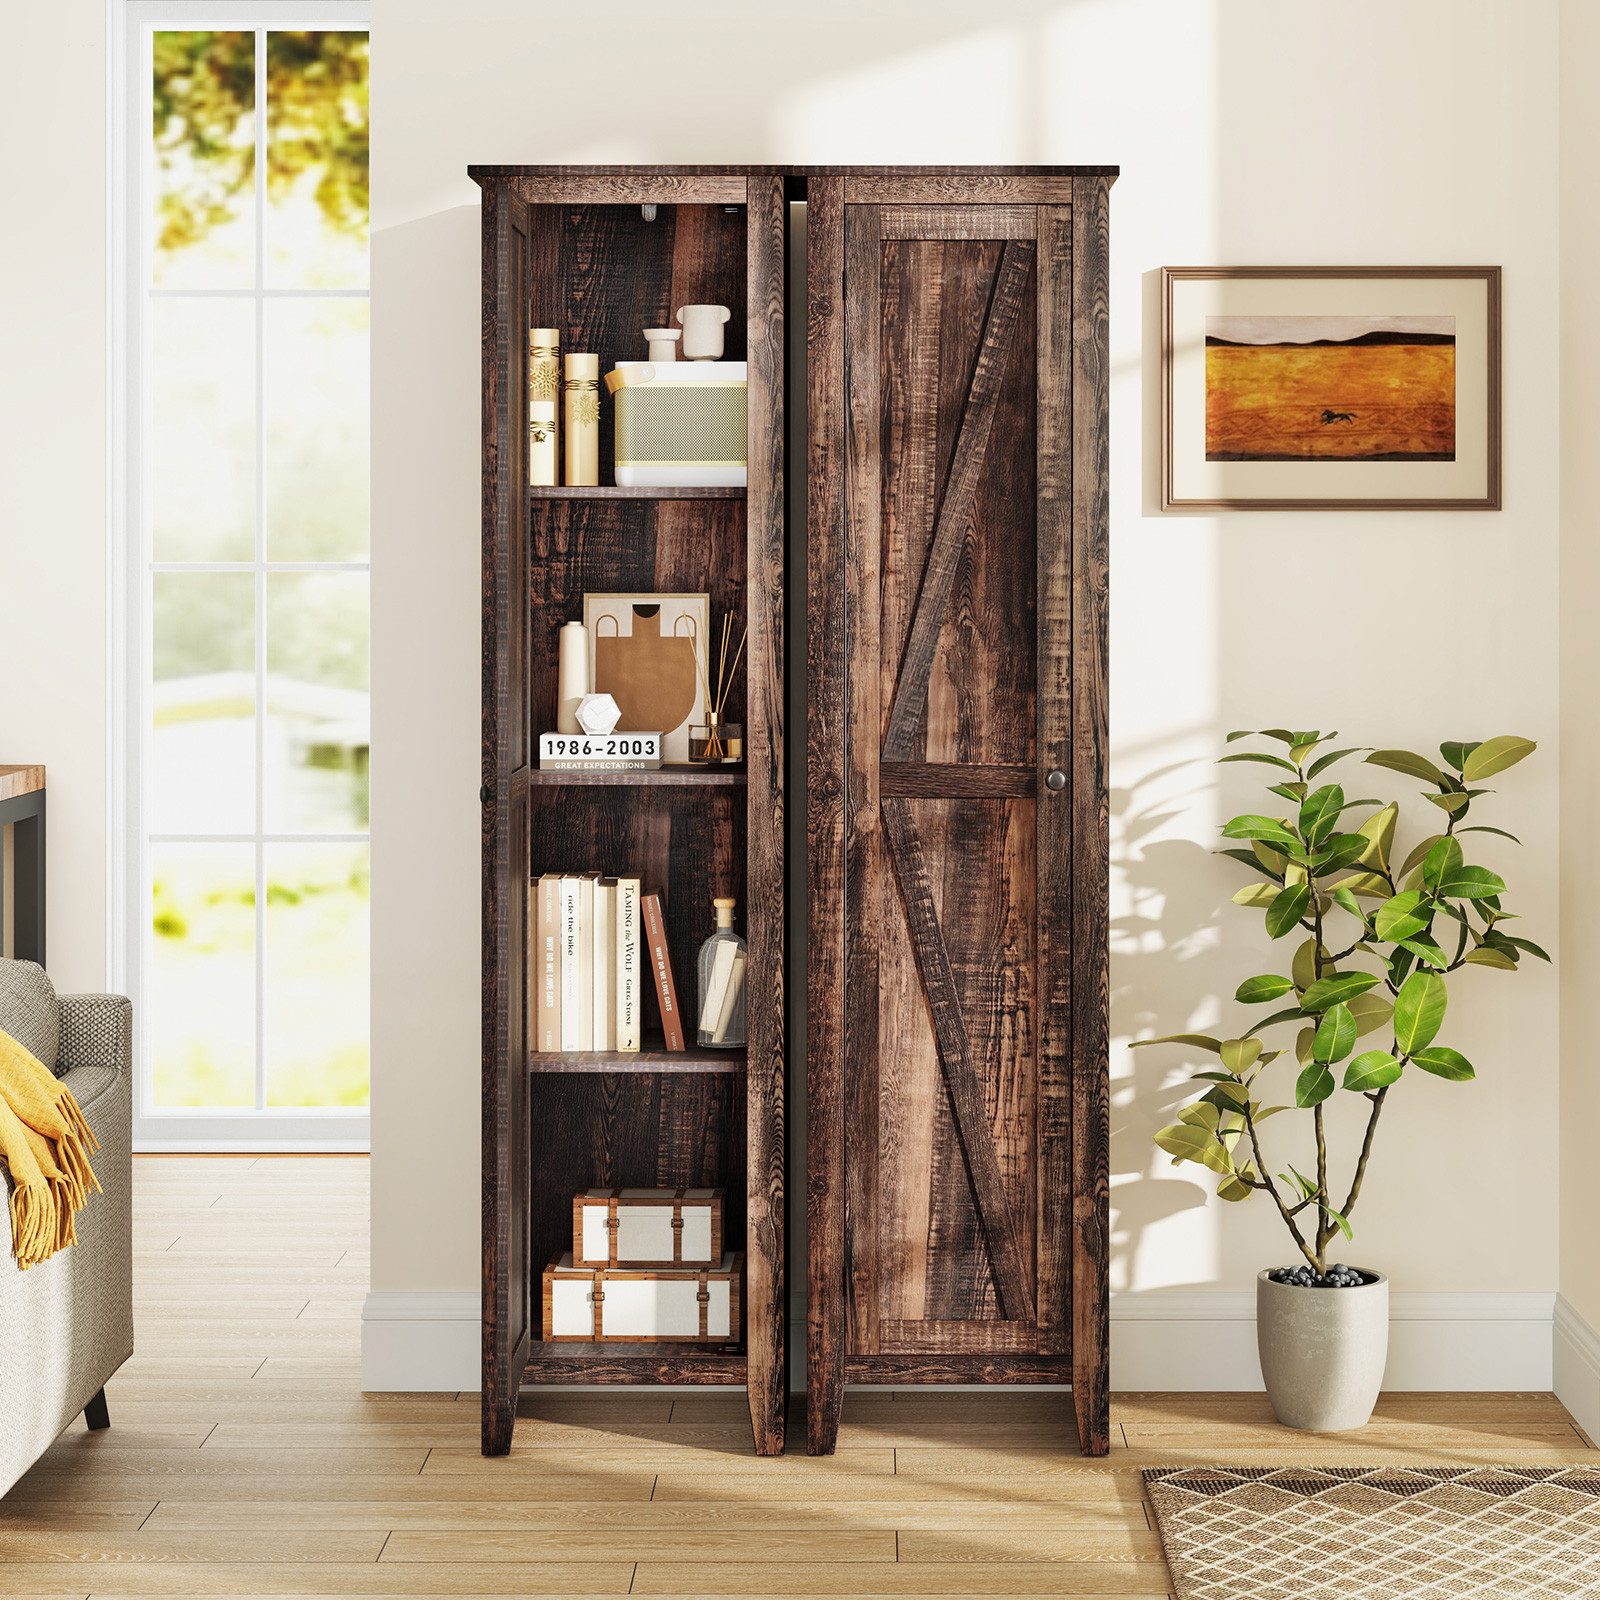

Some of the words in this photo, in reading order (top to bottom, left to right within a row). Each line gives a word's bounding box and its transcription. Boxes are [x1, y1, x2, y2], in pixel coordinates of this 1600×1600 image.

[547, 740, 655, 755] 1986-2003
[625, 884, 635, 927] TAMING
[546, 936, 554, 952] WHY
[625, 942, 635, 973] WOLF
[655, 946, 664, 960] WHY
[546, 974, 554, 991] LOVE
[661, 981, 670, 997] LOVE
[546, 991, 554, 1008] CATS
[664, 997, 673, 1012] CATS
